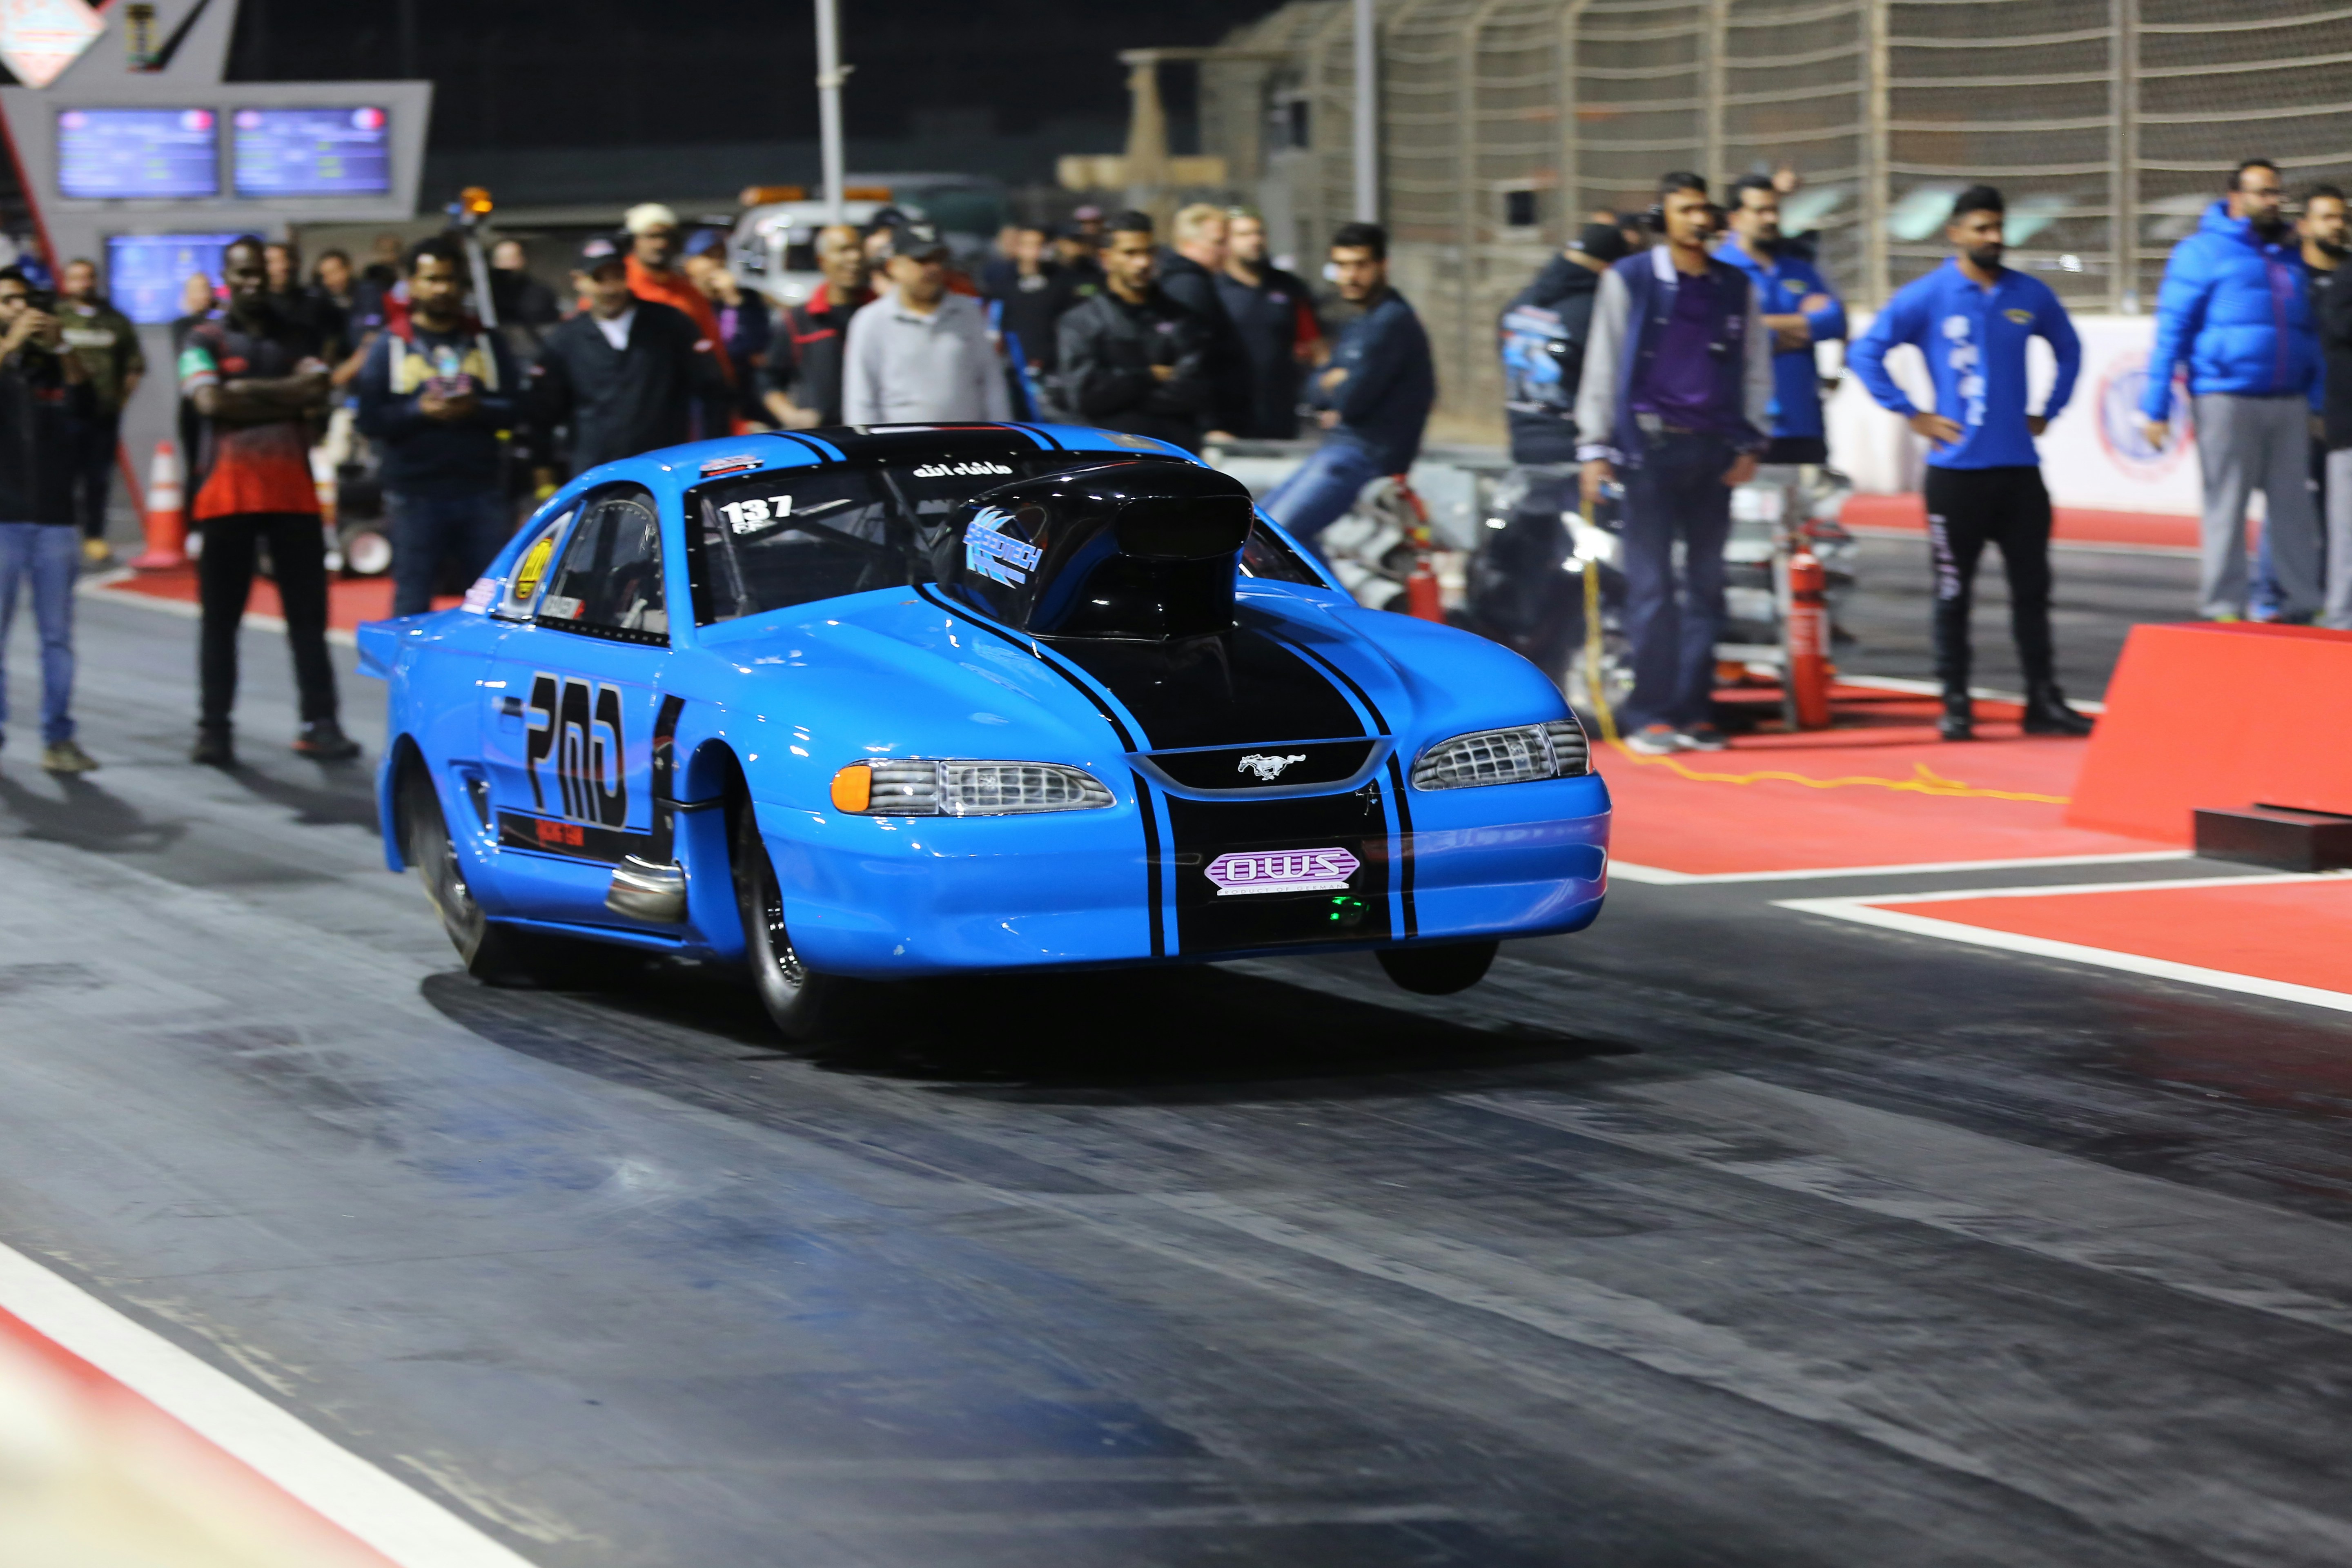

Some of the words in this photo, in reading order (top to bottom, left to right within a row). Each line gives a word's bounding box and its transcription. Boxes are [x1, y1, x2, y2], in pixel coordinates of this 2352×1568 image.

[913, 464, 955, 477] الله
[953, 461, 1013, 475] ماشاء
[719, 495, 792, 523] 137
[962, 521, 1043, 572] SPEEDTECH
[1226, 853, 1341, 881] OWS
